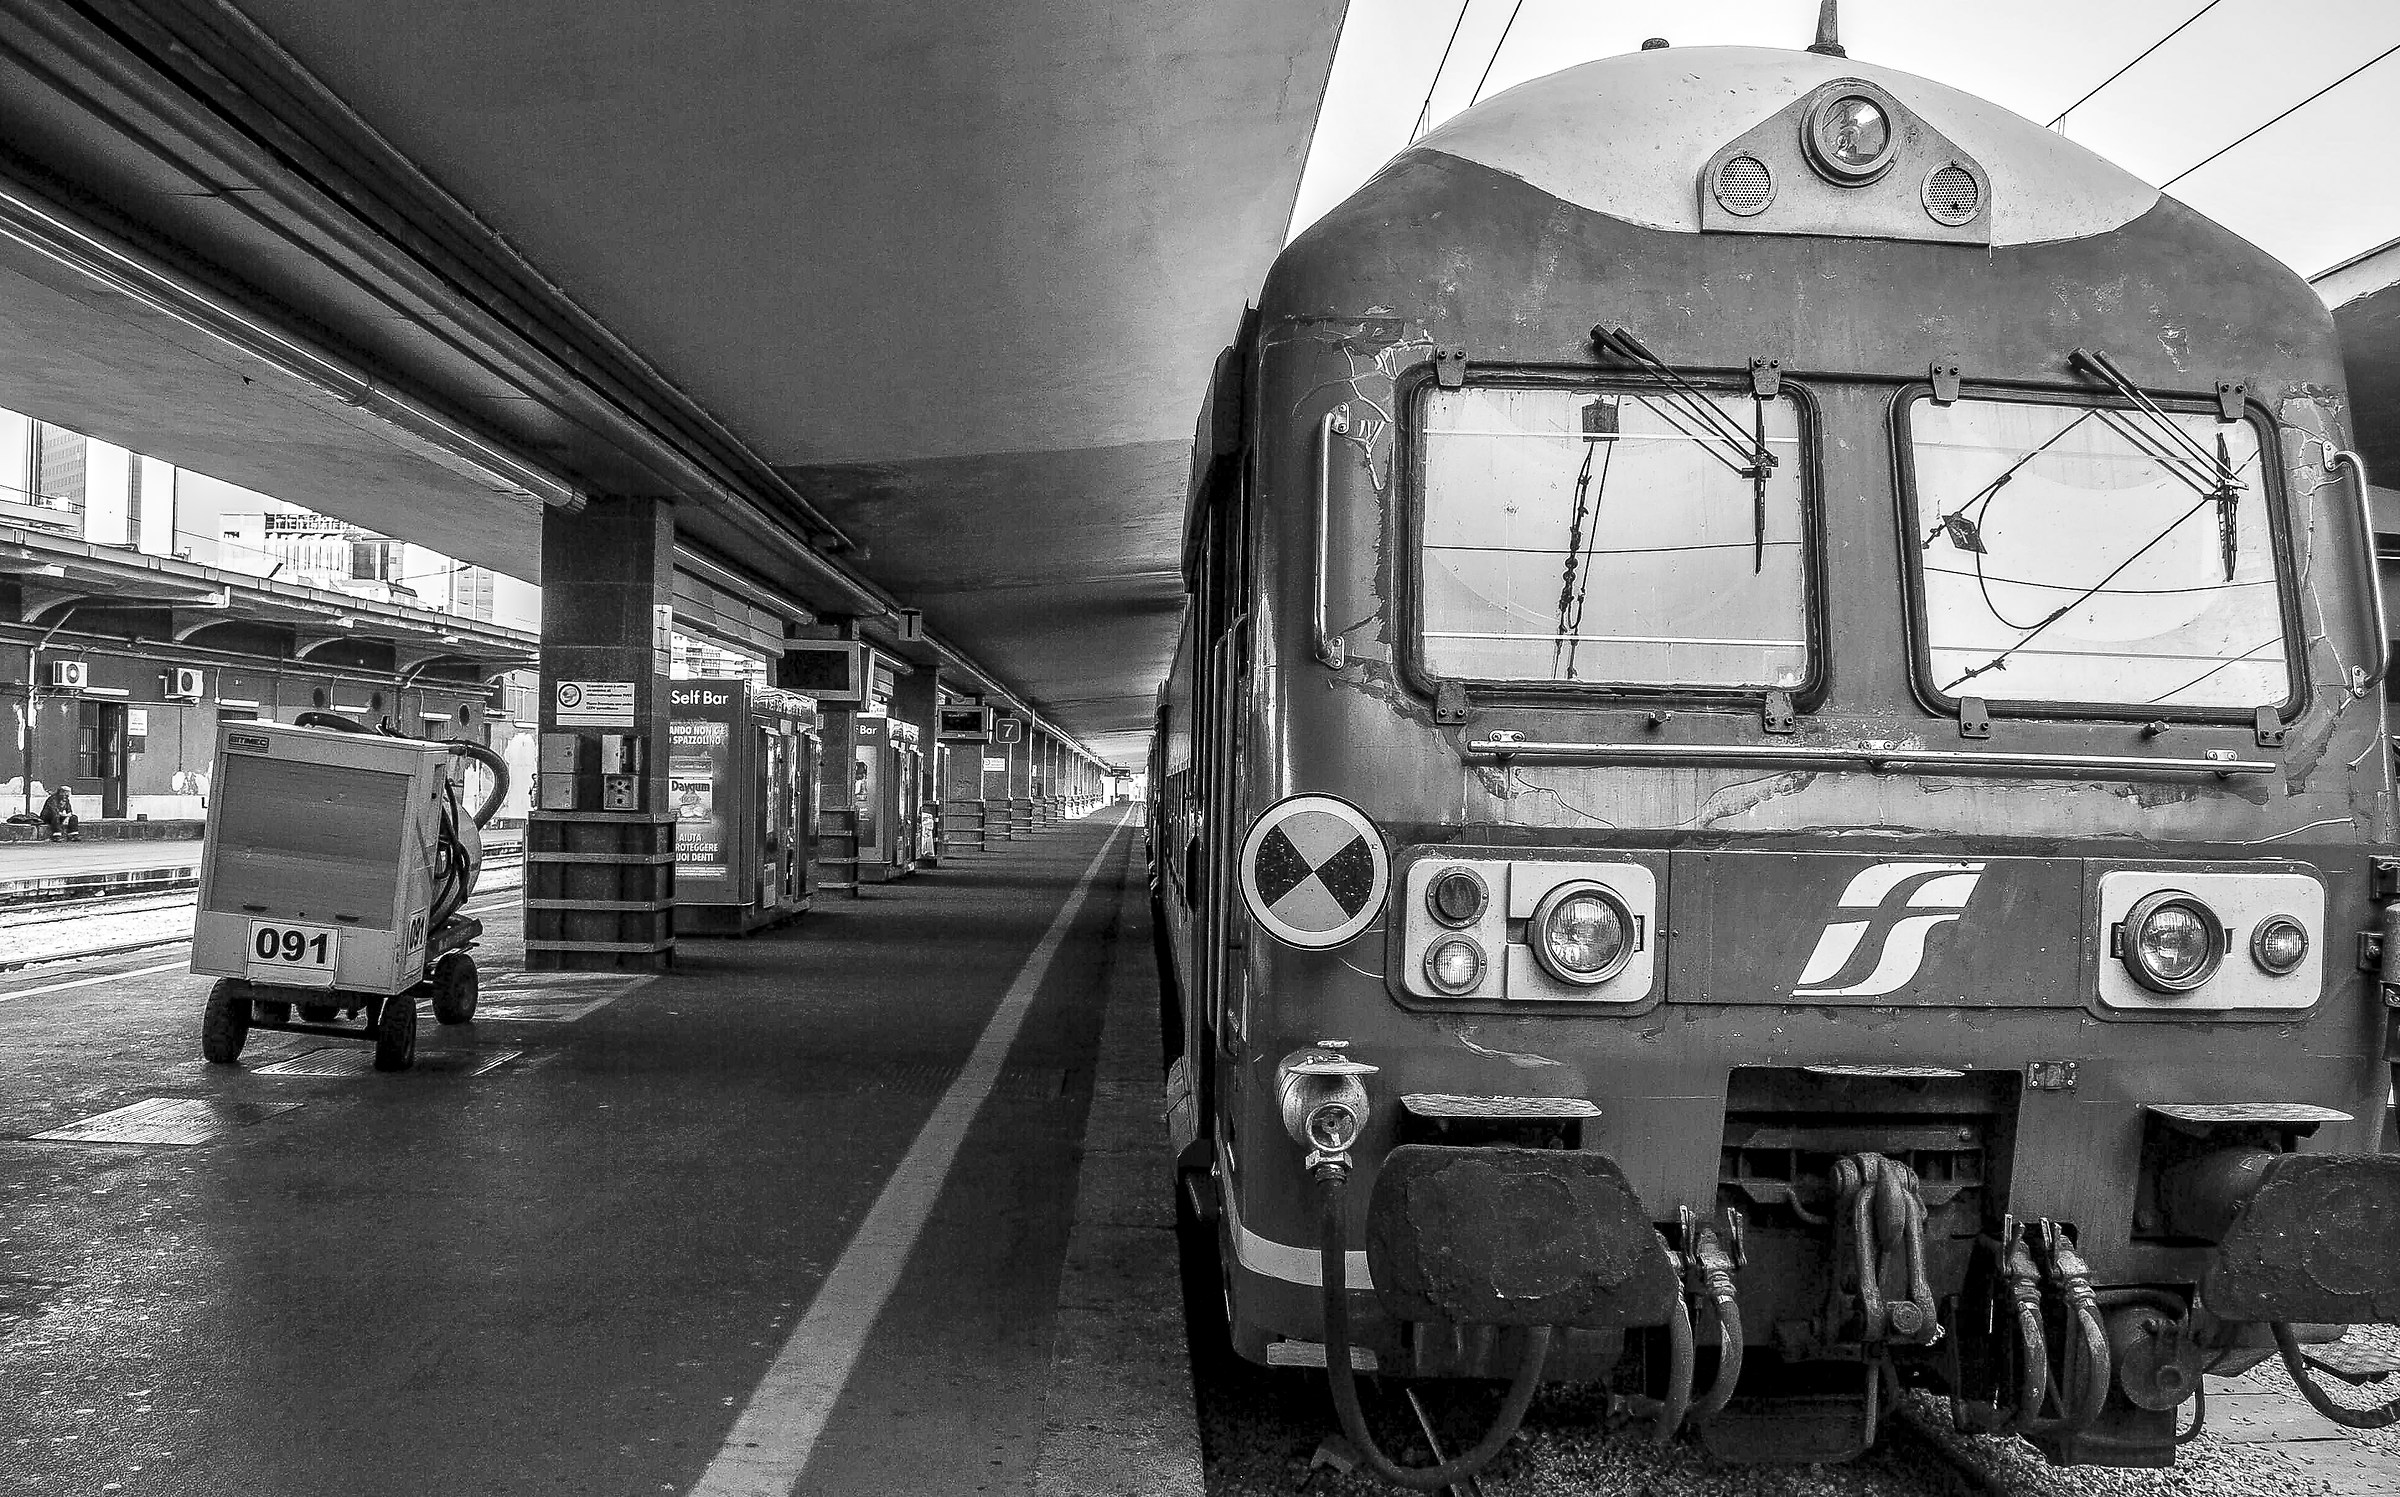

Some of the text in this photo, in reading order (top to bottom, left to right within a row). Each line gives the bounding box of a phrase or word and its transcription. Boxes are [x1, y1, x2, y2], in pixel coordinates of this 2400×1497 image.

[670, 689, 729, 705] Self Bar
[1002, 724, 1014, 738] 7
[671, 780, 711, 793] Daygum
[679, 833, 702, 842] AIUTA
[675, 842, 718, 852] ROTEGGERE
[691, 852, 714, 862] DENTI
[256, 927, 328, 964] 091
